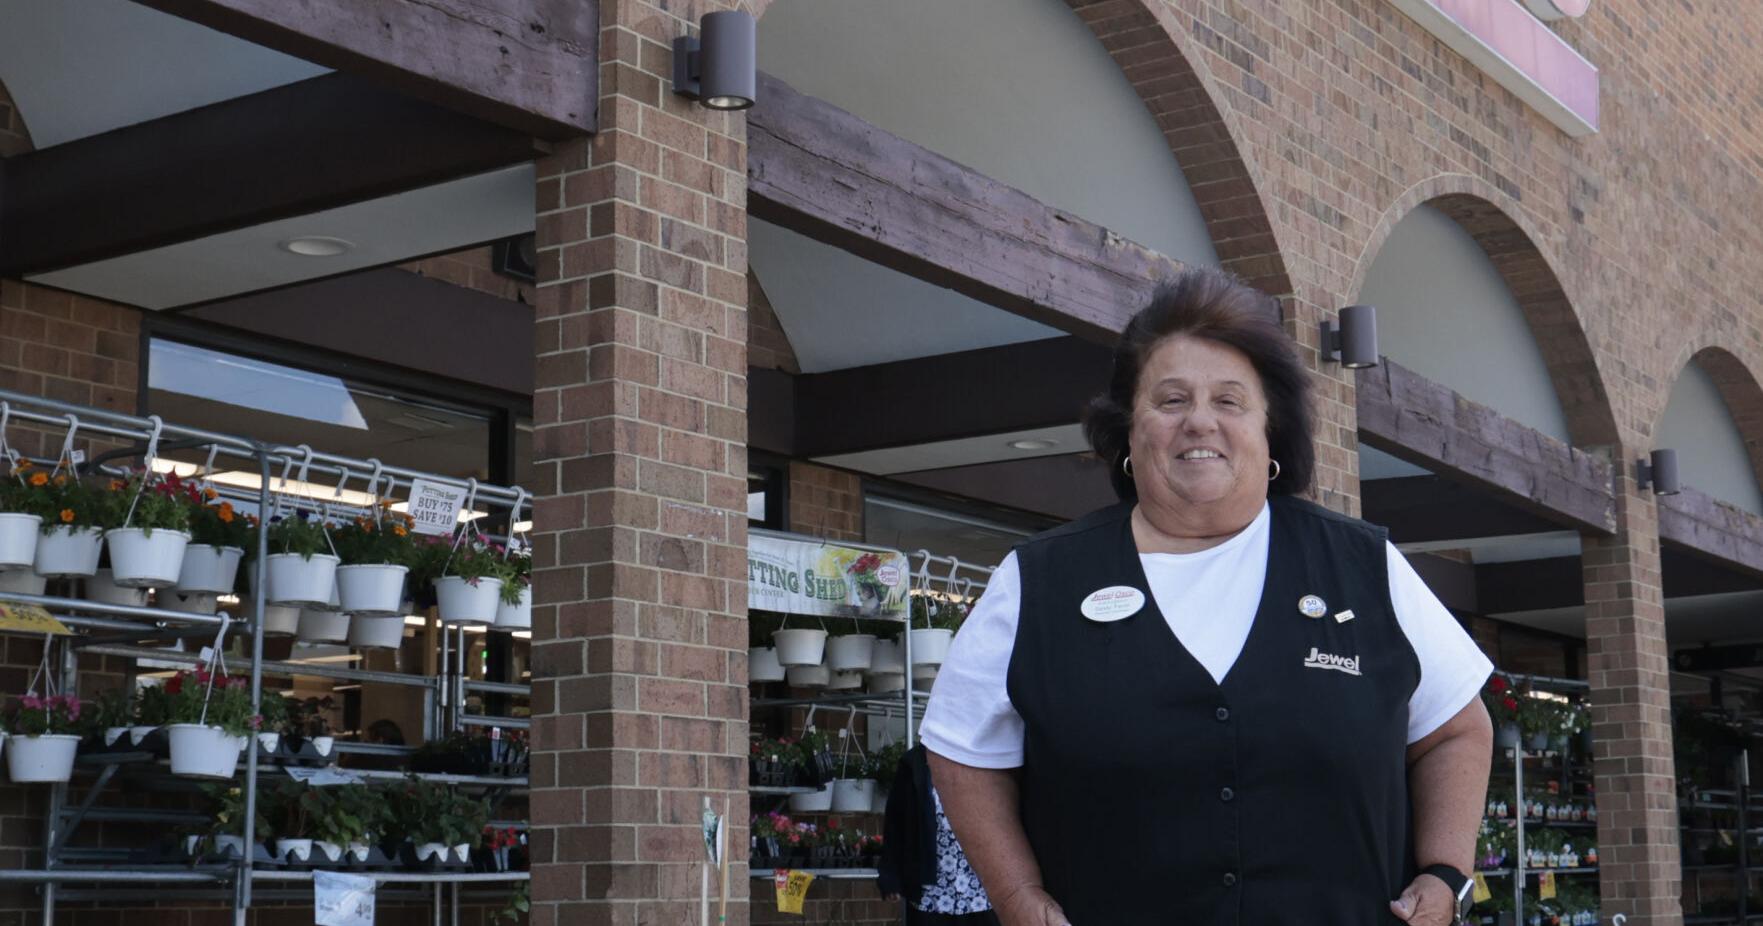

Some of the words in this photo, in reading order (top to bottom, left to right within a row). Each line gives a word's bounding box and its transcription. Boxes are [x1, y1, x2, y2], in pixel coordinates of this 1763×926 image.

[417, 497, 439, 510] BUY
[413, 509, 438, 523] SAVE
[804, 568, 847, 600] SHED
[1304, 647, 1360, 675] Jewel
